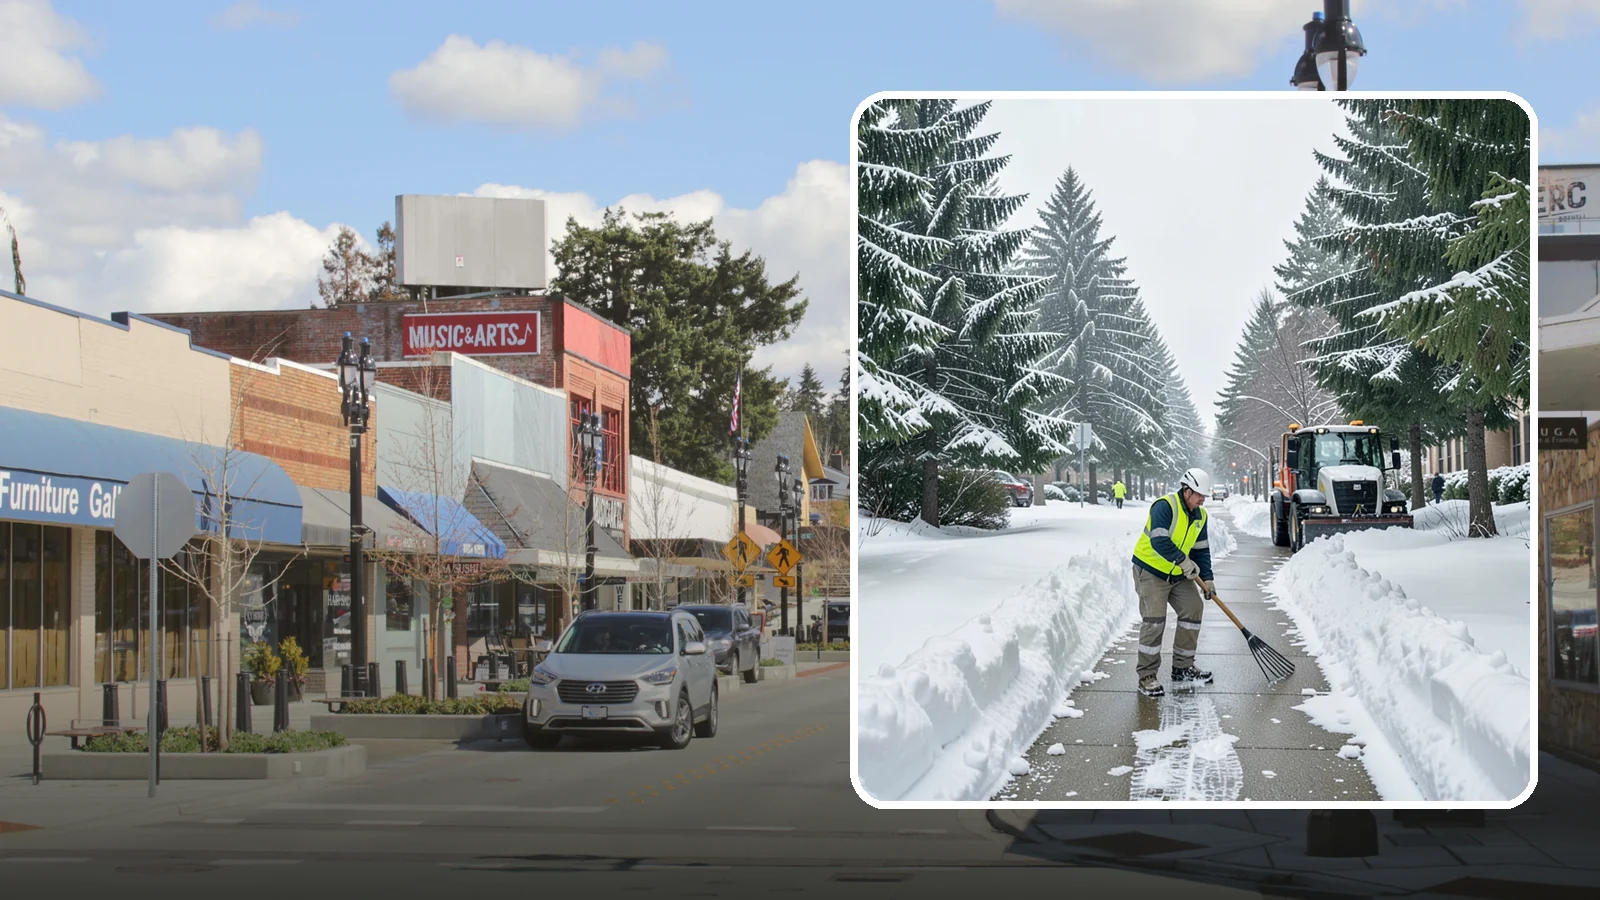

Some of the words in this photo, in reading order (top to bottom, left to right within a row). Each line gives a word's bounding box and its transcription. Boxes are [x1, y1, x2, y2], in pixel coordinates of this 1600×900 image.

[409, 322, 519, 349] MUSIC&ARTS
[0, 471, 80, 515] Furniture
[89, 482, 122, 519] Gal
